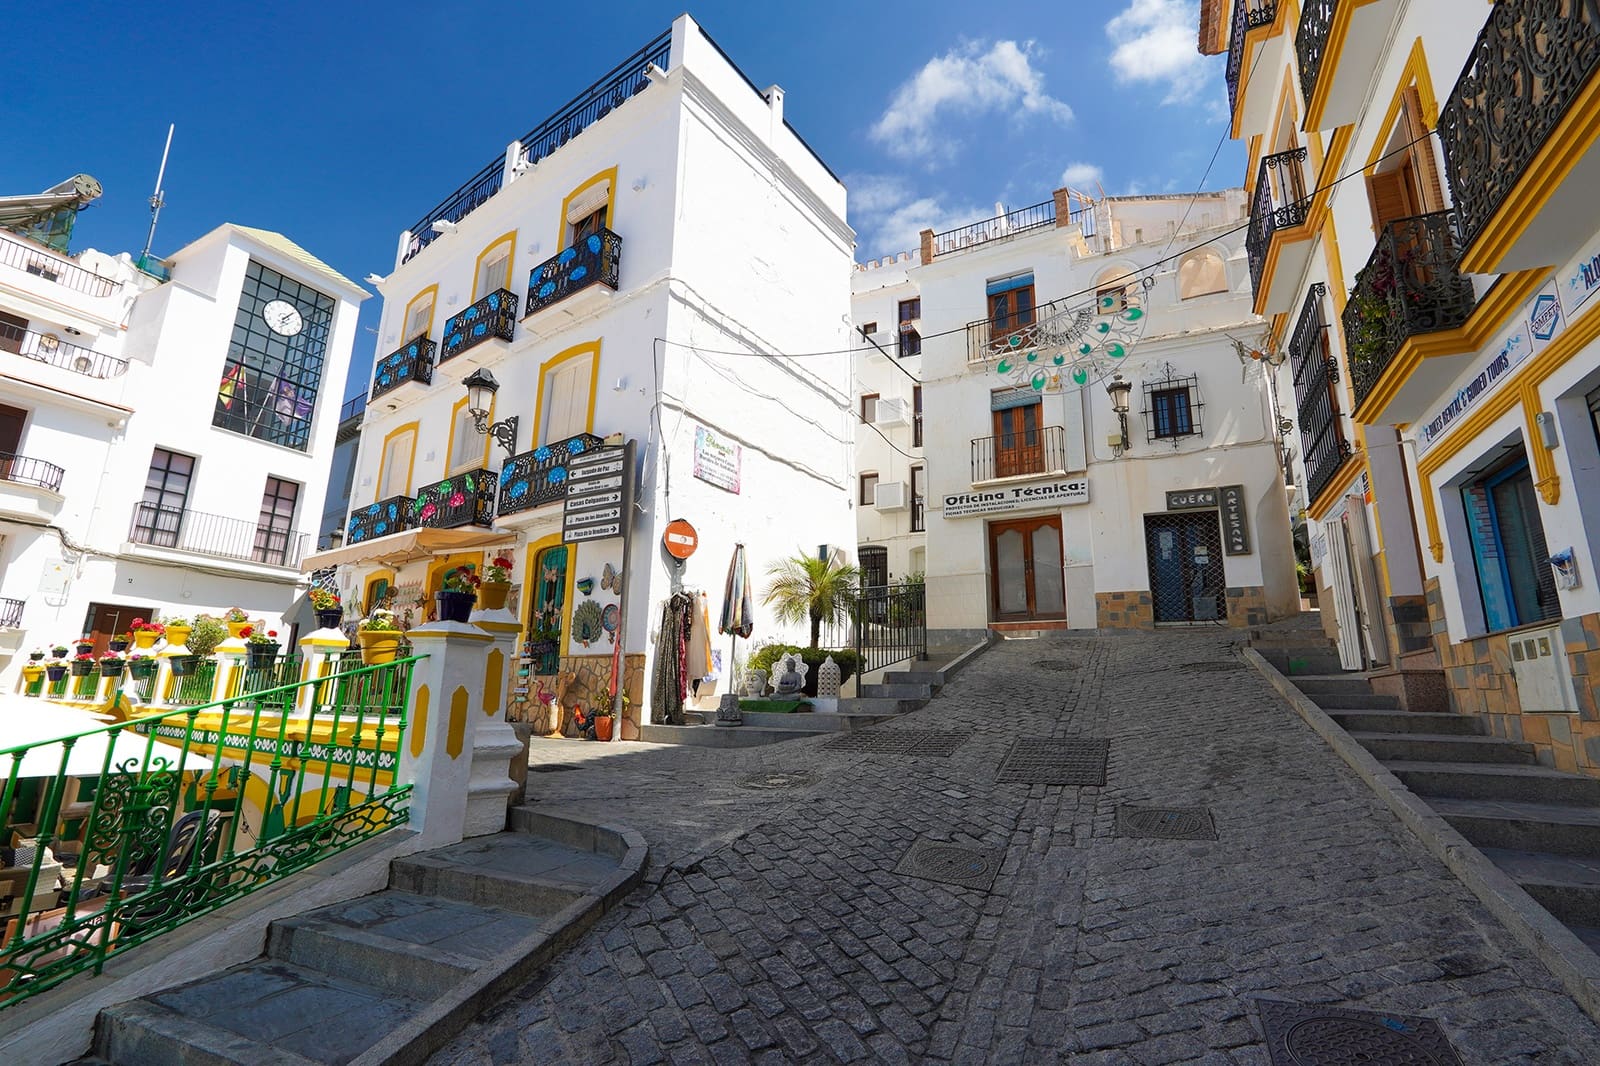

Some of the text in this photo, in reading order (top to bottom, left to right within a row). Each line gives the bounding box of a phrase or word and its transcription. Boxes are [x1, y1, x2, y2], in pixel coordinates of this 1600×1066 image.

[1441, 395, 1463, 426] RENTAL
[1466, 371, 1488, 403] GUIDED
[1486, 350, 1510, 383] TOURS
[945, 481, 1086, 506] Oficina Técnica:
[585, 496, 610, 505] Colgantes
[1021, 495, 1047, 503] LICENCIAS
[987, 504, 1015, 512] REDUCIDAS
